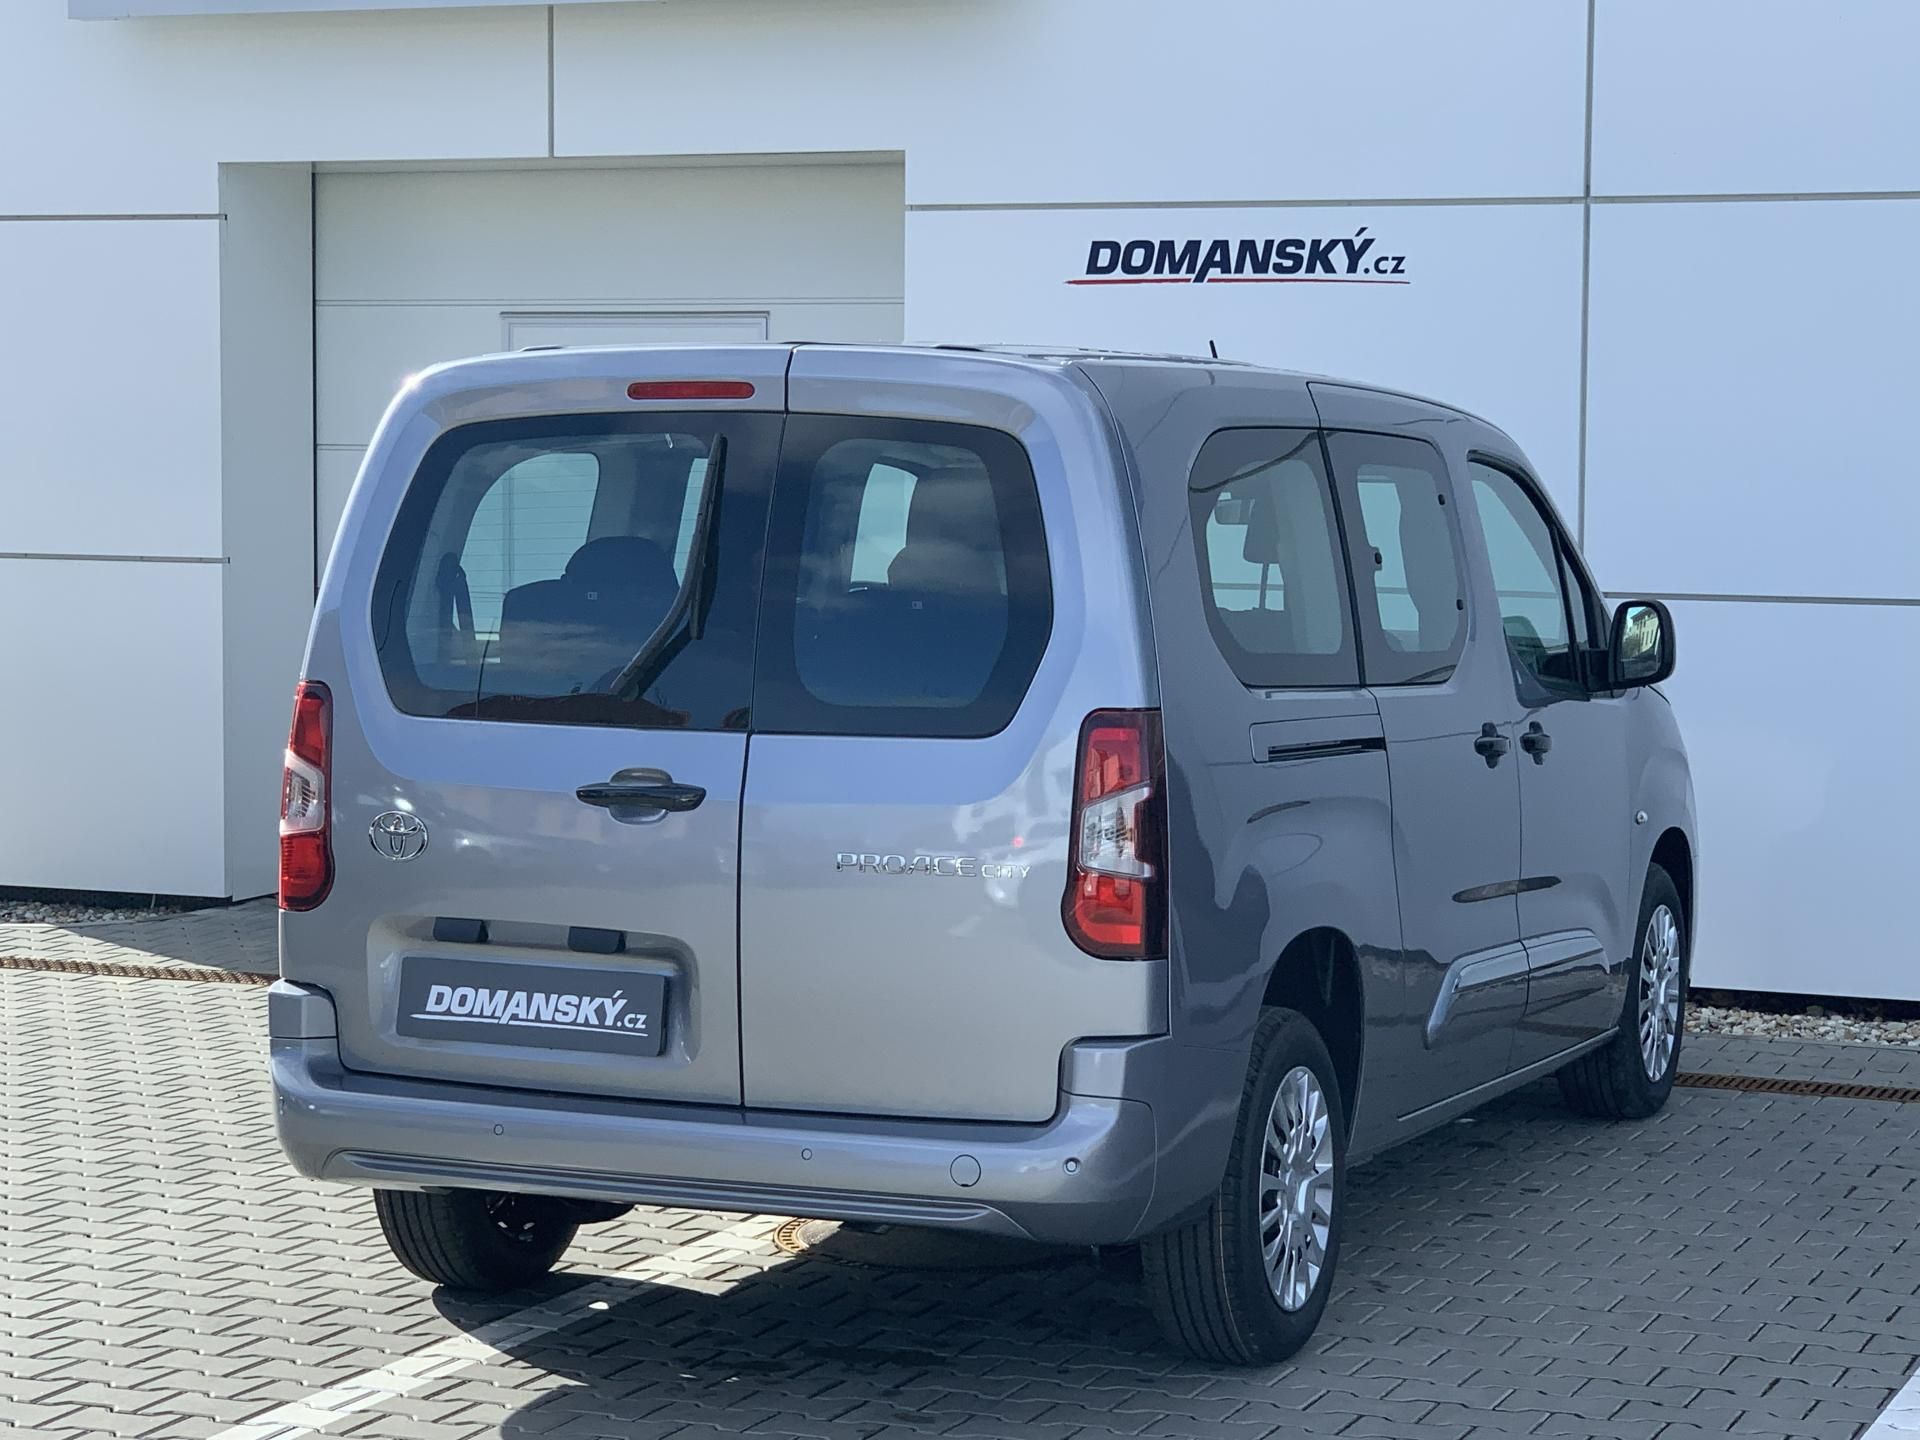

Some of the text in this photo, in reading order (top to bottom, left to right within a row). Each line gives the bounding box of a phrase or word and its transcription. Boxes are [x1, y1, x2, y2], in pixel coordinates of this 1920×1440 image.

[1086, 227, 1406, 283] DOMANSKÝ.cz
[836, 852, 1032, 879] PROACE CITY
[425, 985, 648, 1029] DOMANSKÝ.cz
